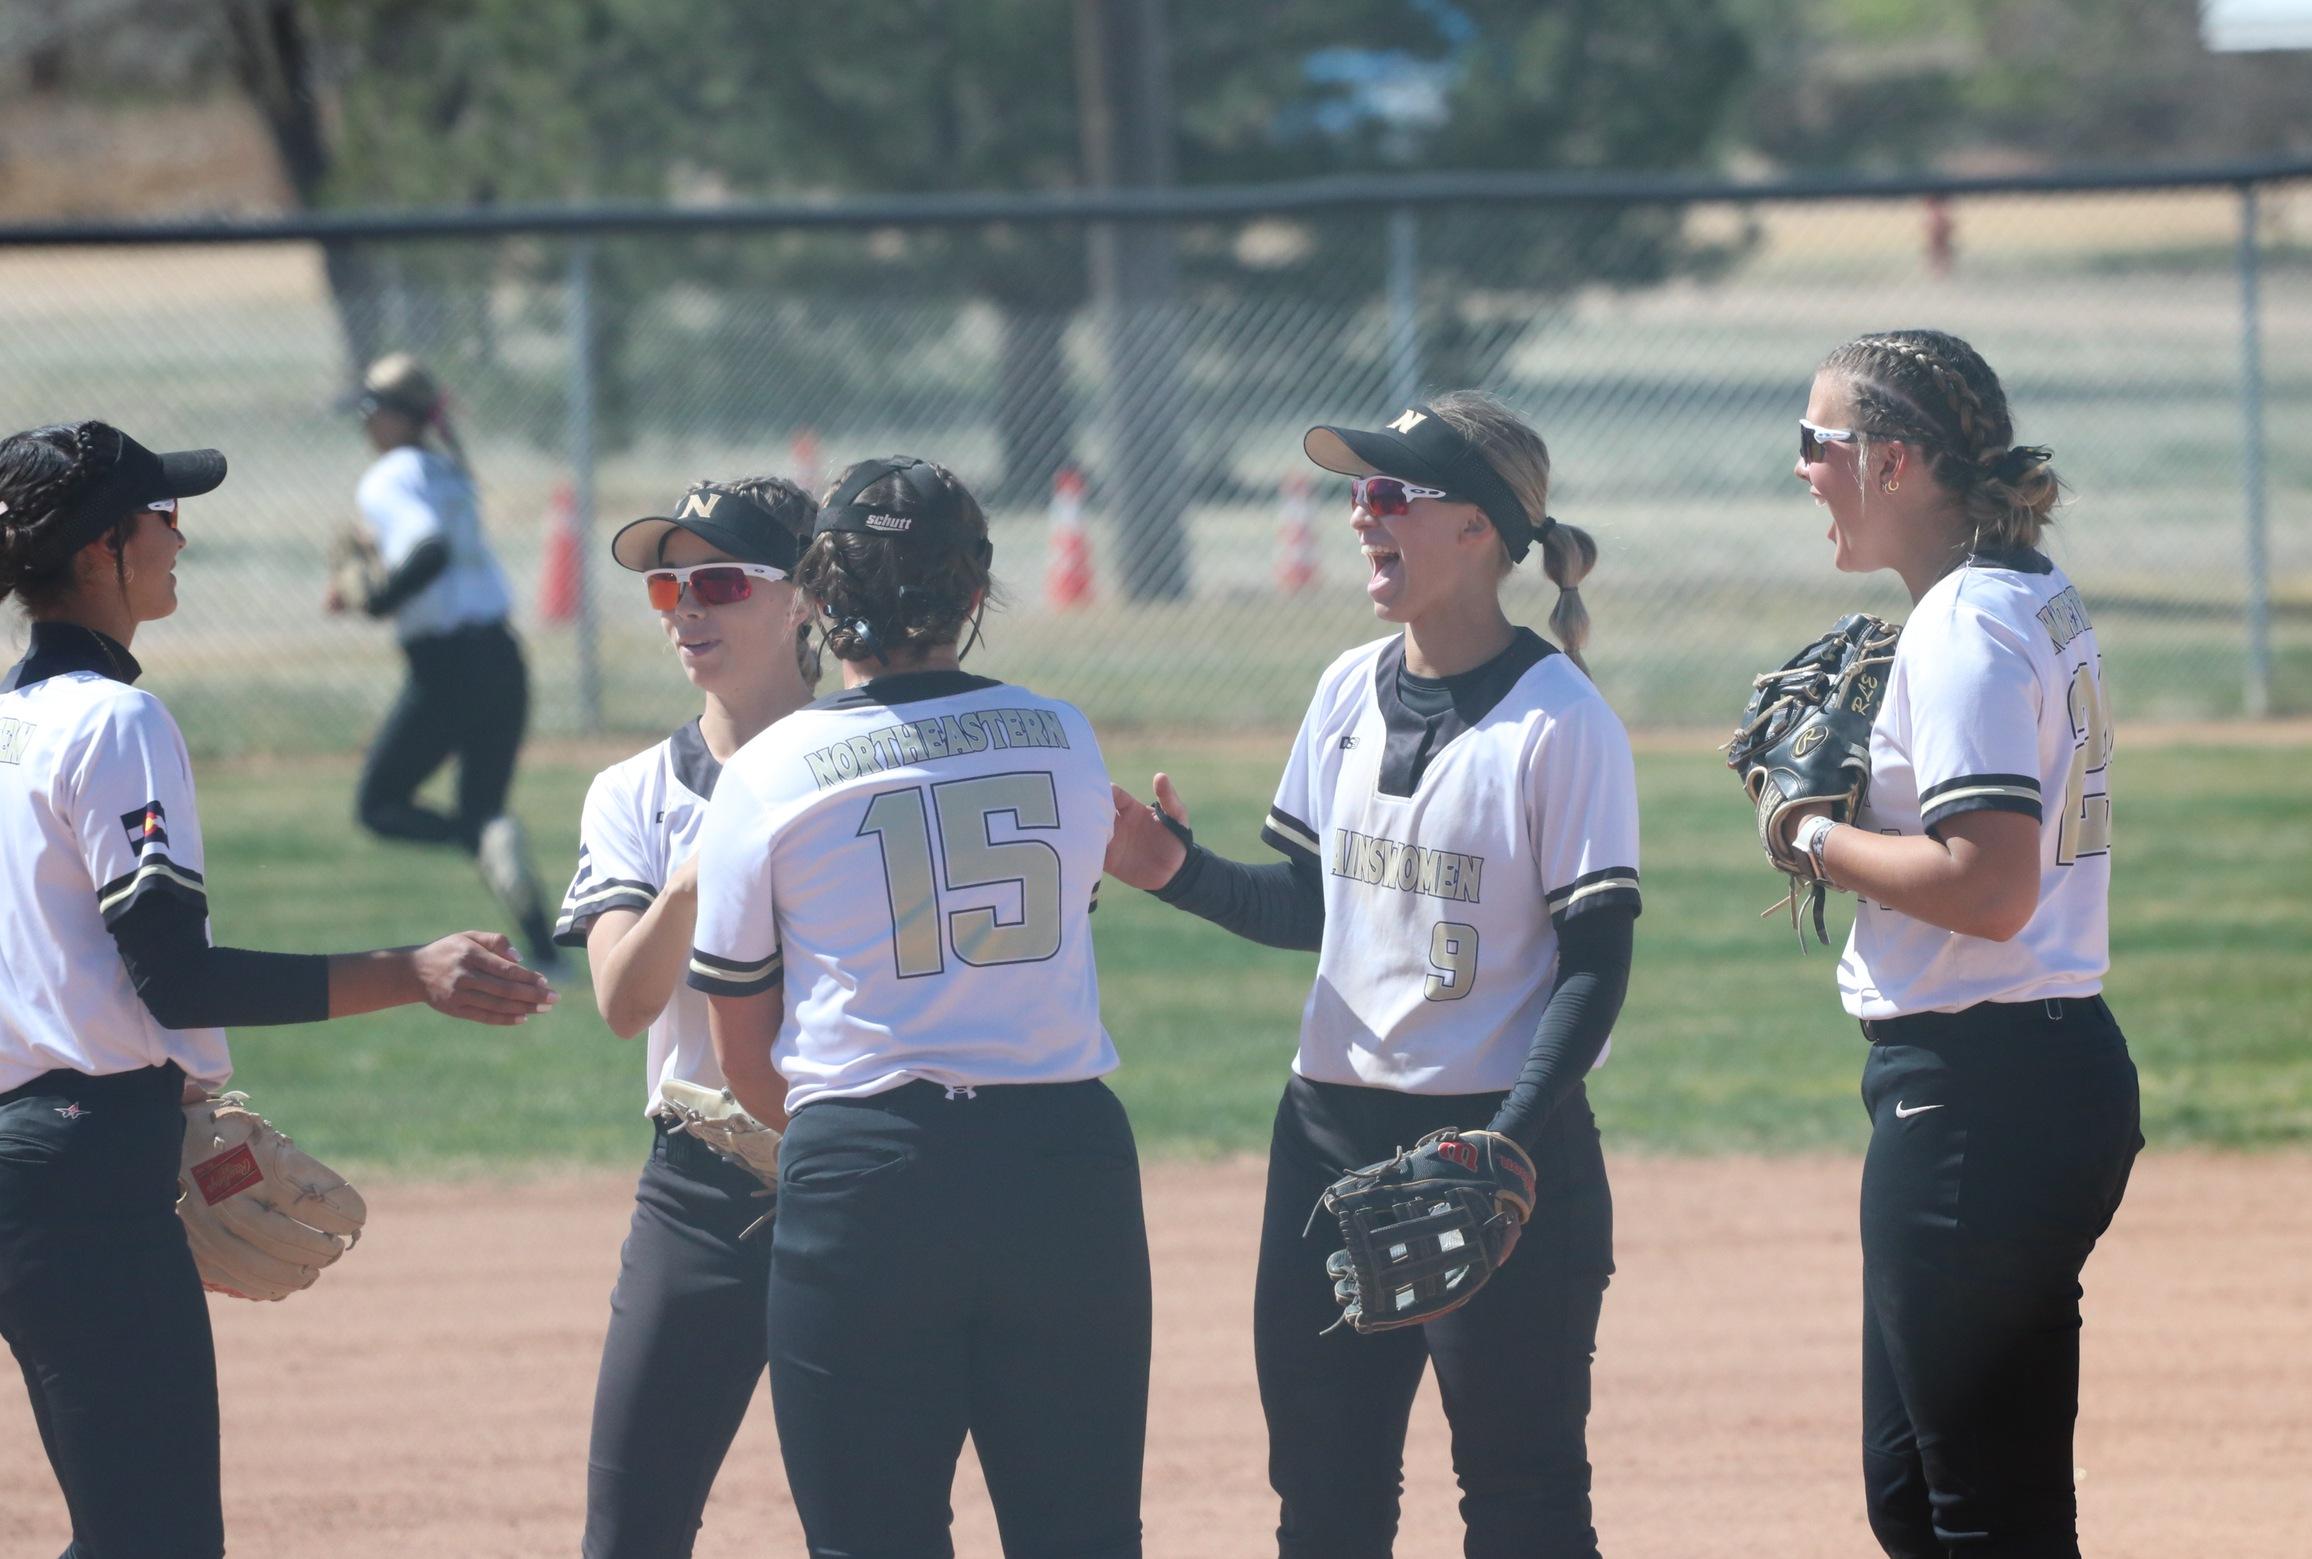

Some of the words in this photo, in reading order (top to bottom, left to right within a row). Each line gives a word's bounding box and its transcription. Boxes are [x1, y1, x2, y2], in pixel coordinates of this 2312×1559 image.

[1385, 409, 1428, 434] N
[677, 493, 722, 519] N
[865, 513, 912, 530] schutt
[804, 707, 1070, 791] NORTHEASTERN
[855, 770, 1062, 980] 15
[1423, 920, 1480, 1002] 9
